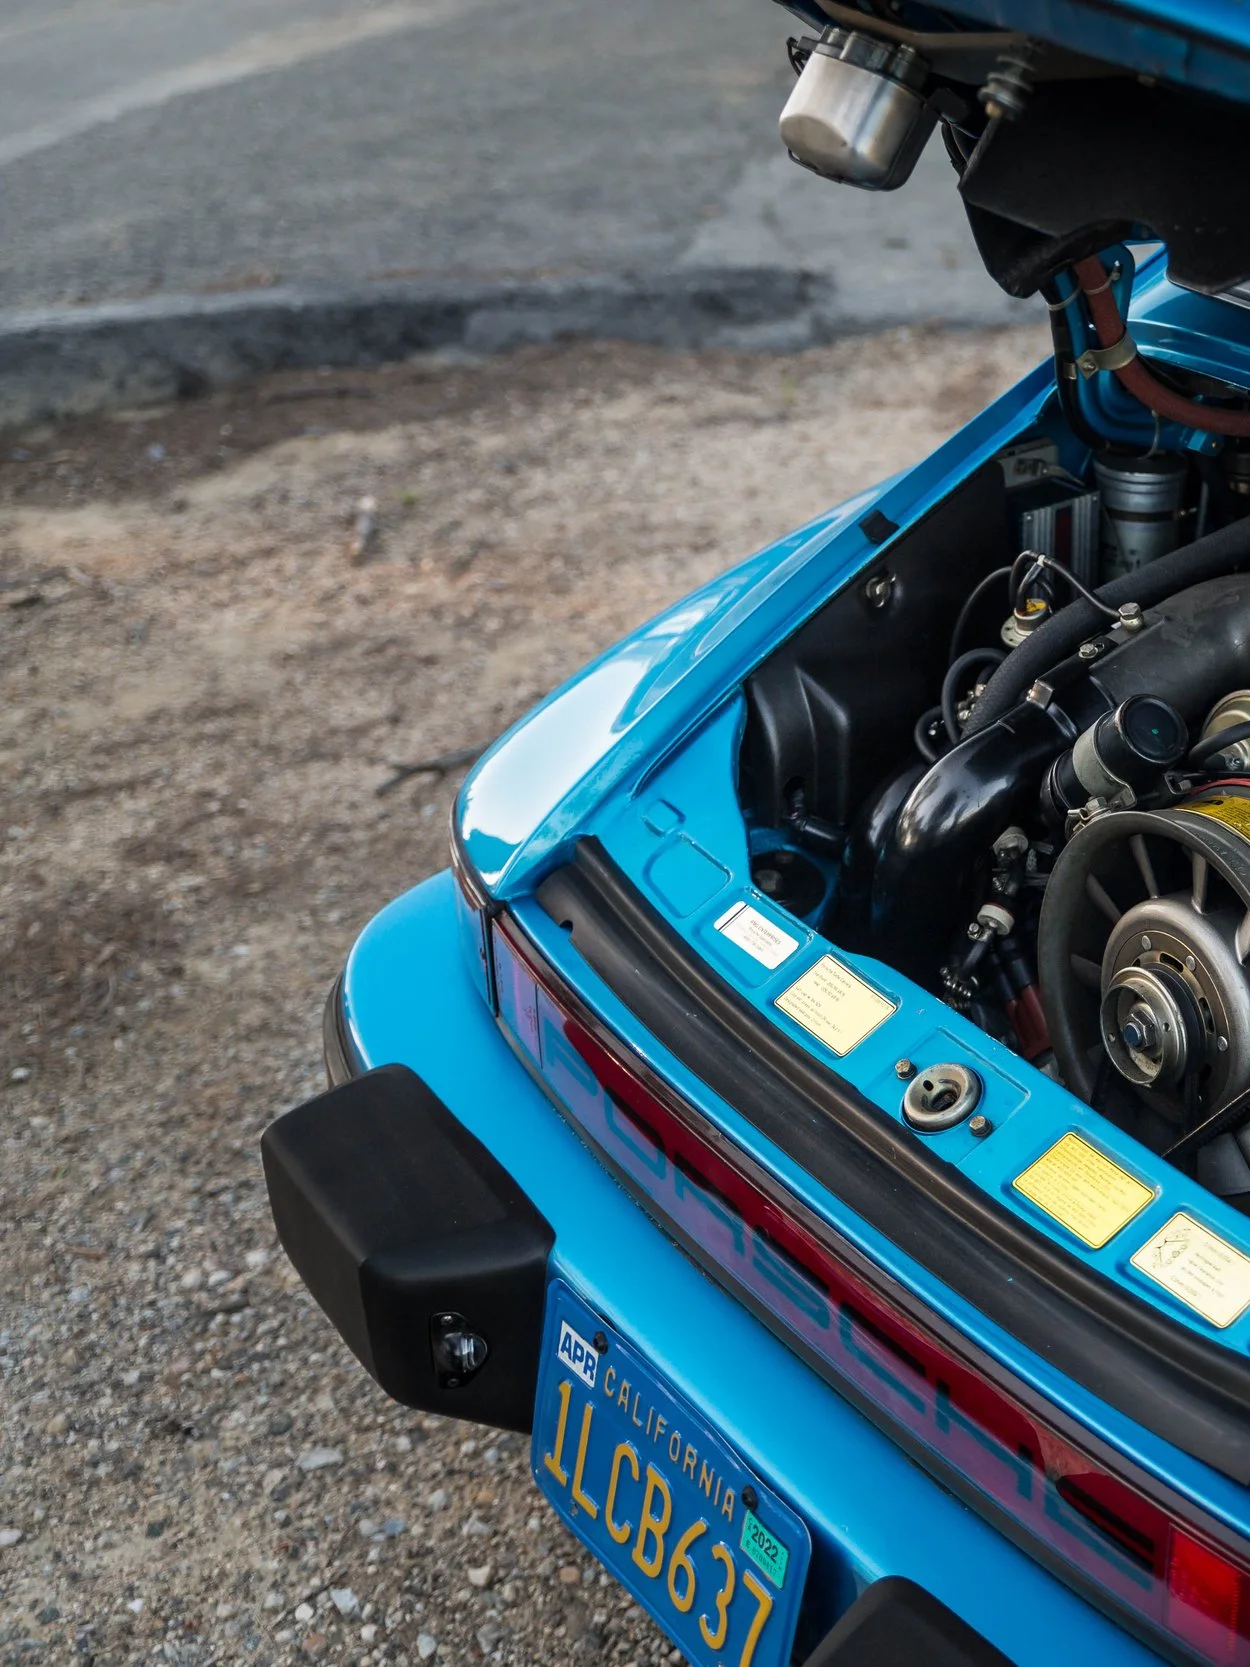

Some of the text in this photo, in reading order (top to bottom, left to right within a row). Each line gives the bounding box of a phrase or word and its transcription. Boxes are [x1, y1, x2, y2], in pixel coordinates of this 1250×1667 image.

[560, 1329, 598, 1384] APR
[603, 1366, 736, 1523] CALIFORNIA
[544, 1380, 774, 1667] 1LCB637
[751, 1524, 779, 1565] 2022
